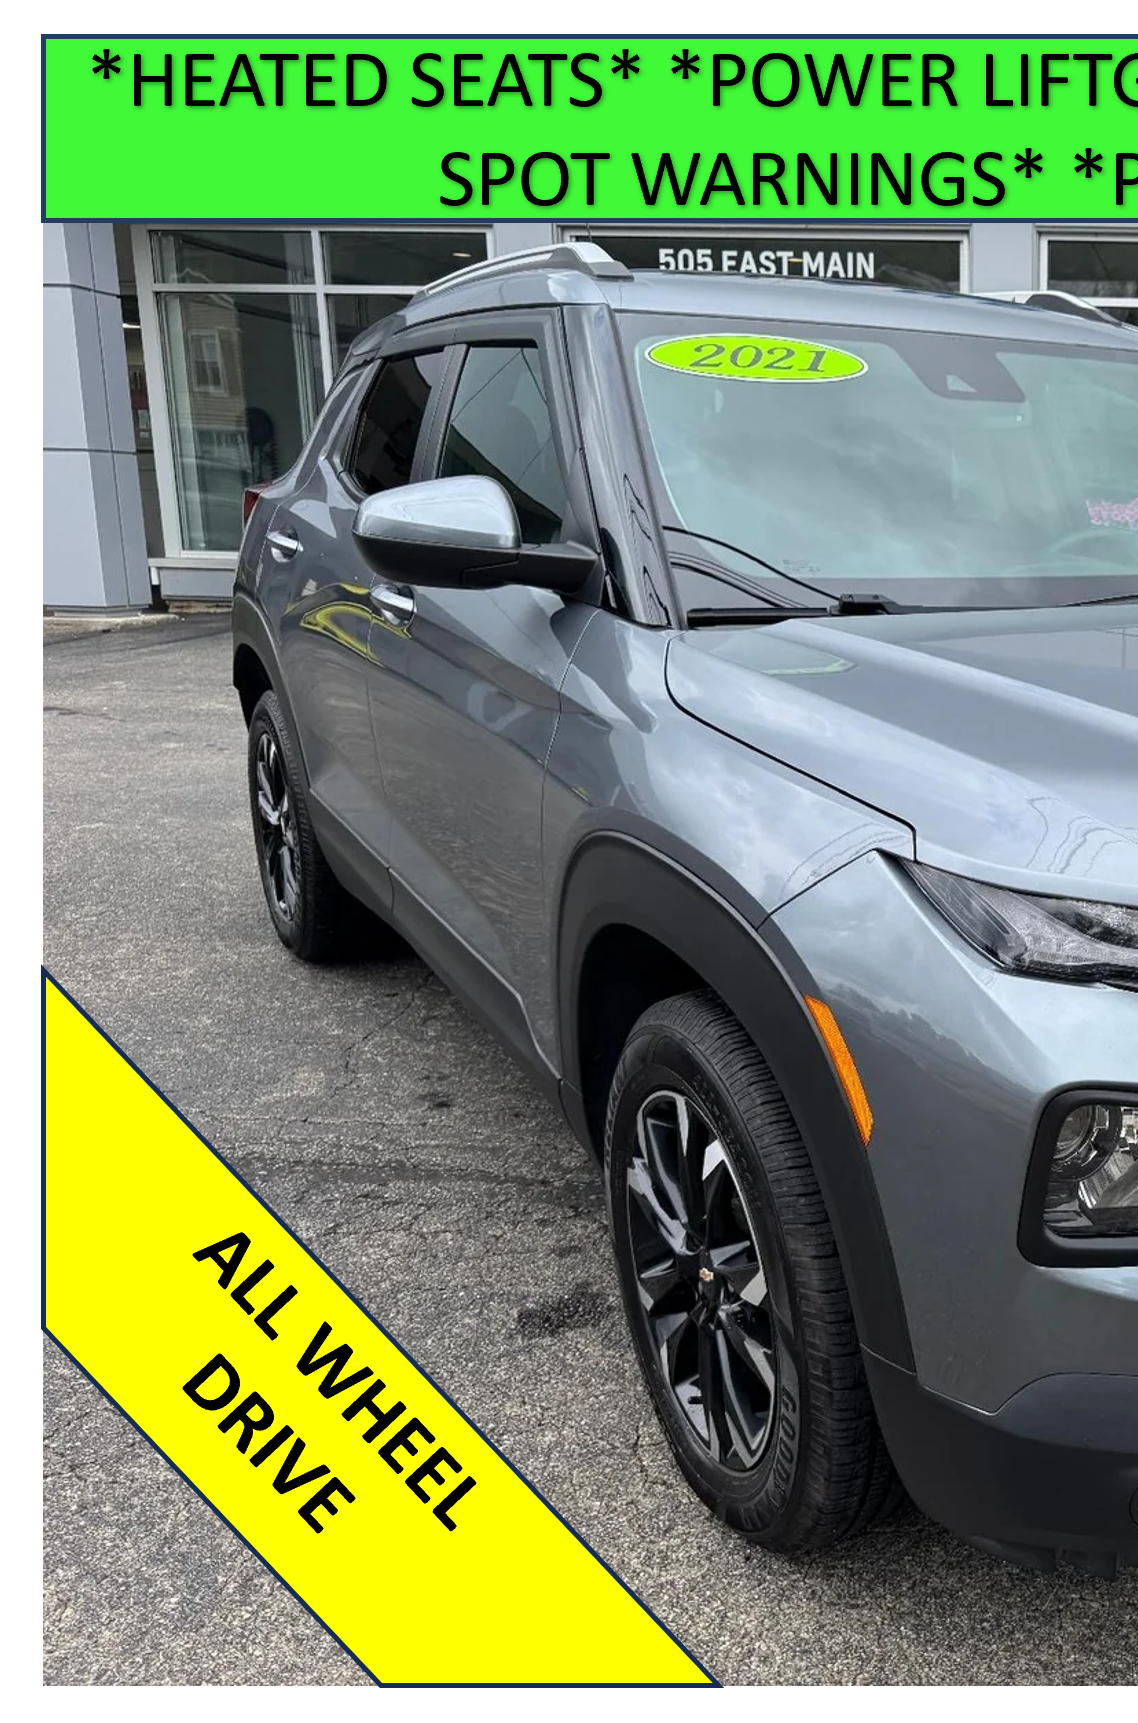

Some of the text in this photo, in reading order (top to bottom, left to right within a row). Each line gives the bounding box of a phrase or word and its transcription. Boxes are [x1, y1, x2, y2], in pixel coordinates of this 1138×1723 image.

[659, 249, 874, 278] 505 EAST MAIN
[689, 344, 826, 372] 2021
